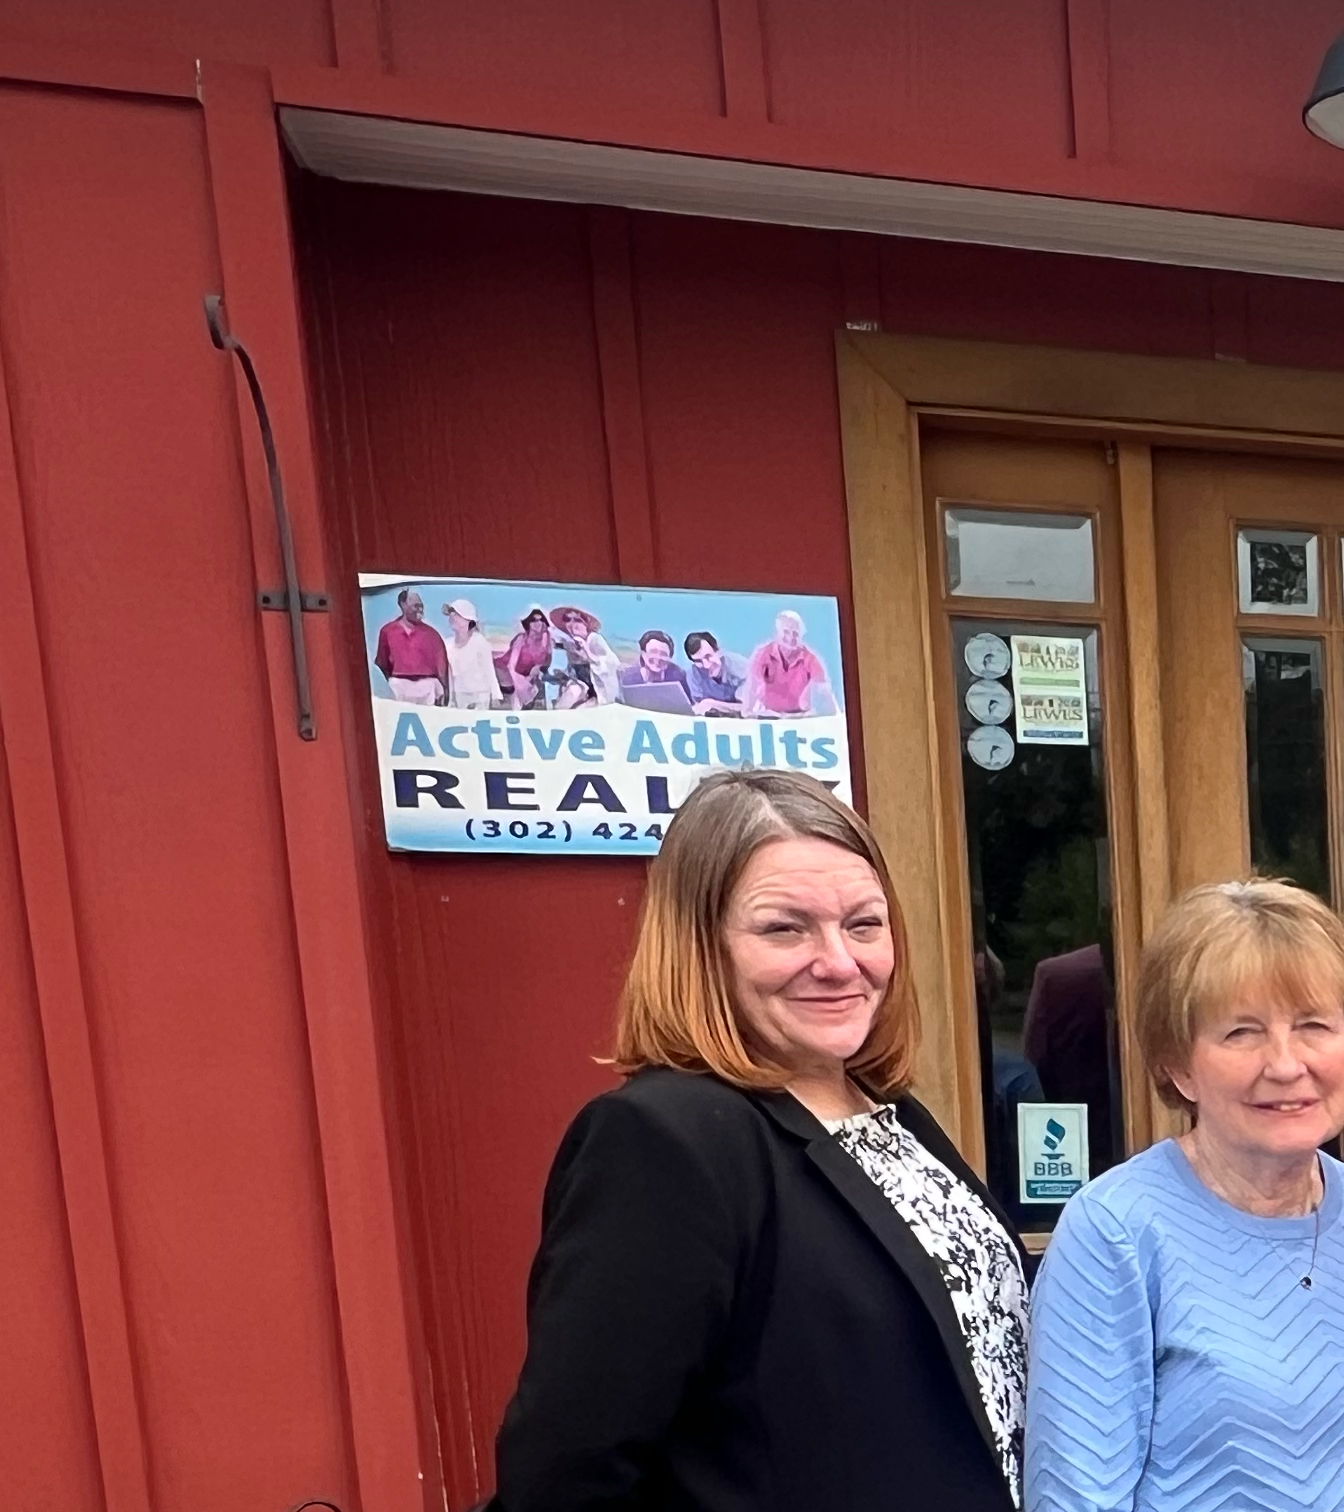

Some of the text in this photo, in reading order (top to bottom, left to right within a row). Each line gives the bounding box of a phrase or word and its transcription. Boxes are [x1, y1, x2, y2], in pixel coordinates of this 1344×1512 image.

[390, 711, 840, 770] Active Adults
[392, 768, 840, 815] REAL
[465, 817, 573, 843] (302)
[1033, 1161, 1073, 1178] BBB
